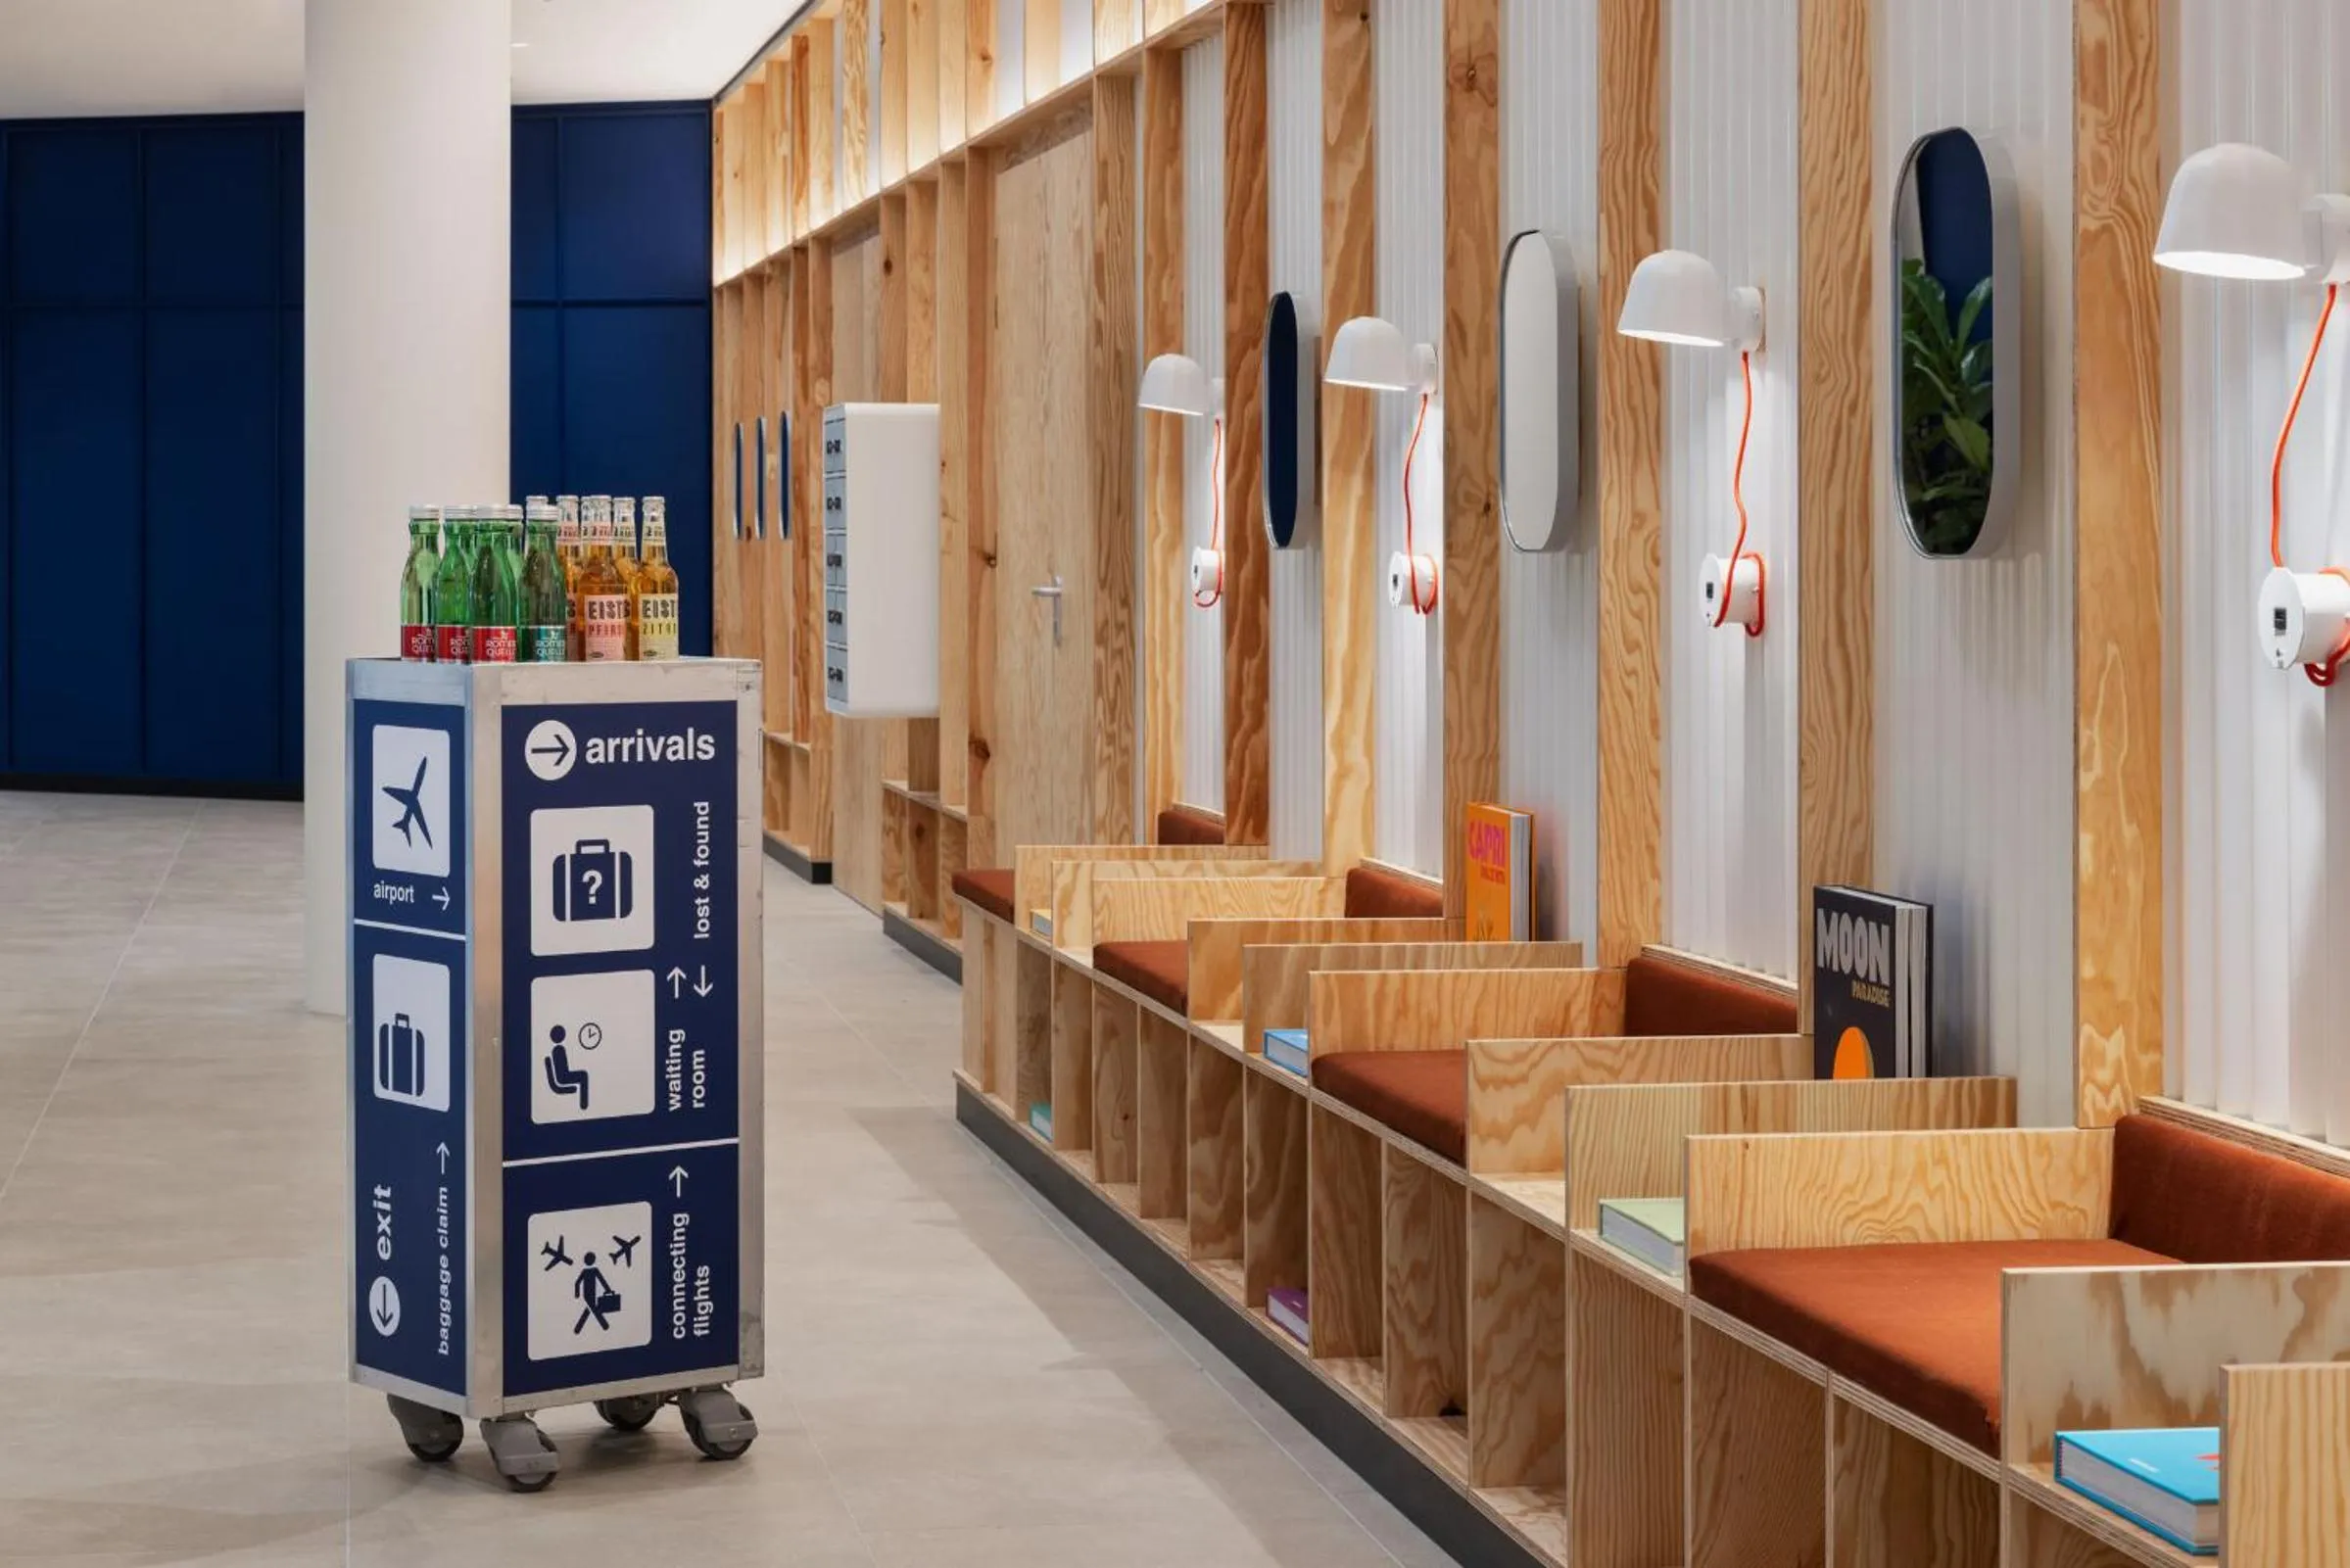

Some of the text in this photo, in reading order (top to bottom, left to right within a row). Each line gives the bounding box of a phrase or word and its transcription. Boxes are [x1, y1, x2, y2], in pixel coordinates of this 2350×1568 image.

[585, 726, 716, 764] arrivals
[373, 879, 415, 906] airport
[693, 801, 710, 939] lost & found
[1816, 907, 1891, 988] MOON
[1850, 979, 1891, 1009] PARADISE
[665, 1028, 687, 1113] waiting
[692, 1048, 706, 1109] room
[371, 1183, 393, 1261] exit
[436, 1186, 453, 1356] baggage claim
[669, 1212, 691, 1340] connecting
[693, 1264, 714, 1338] flights
